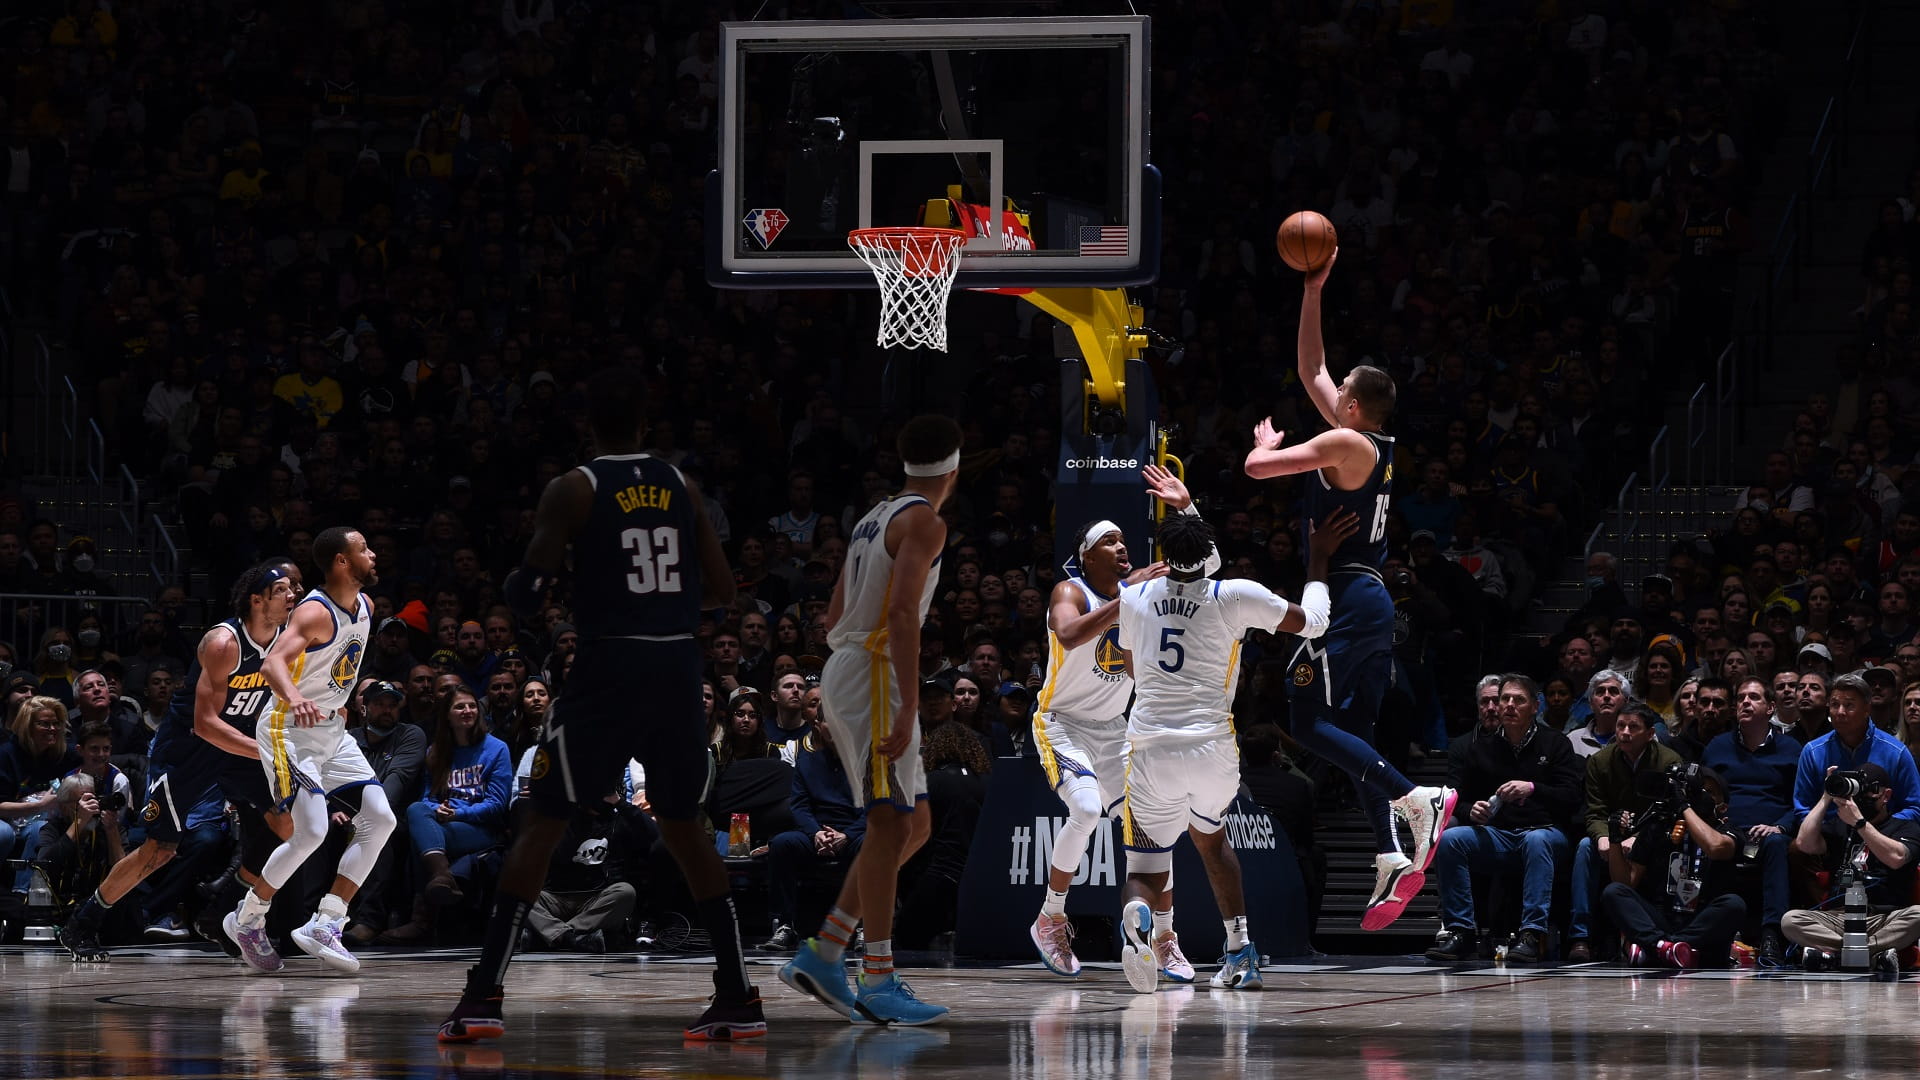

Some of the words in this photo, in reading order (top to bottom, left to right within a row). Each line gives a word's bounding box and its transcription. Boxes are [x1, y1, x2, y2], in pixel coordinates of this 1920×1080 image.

[769, 214, 779, 227] 75
[1065, 456, 1137, 469] coinbase
[615, 484, 672, 513] GREEN
[1369, 494, 1389, 542] 15
[621, 526, 682, 593] 32
[1154, 597, 1200, 619] LOONEY
[1158, 628, 1185, 673] 5
[225, 691, 264, 716] 50
[1224, 800, 1275, 849] oinbase
